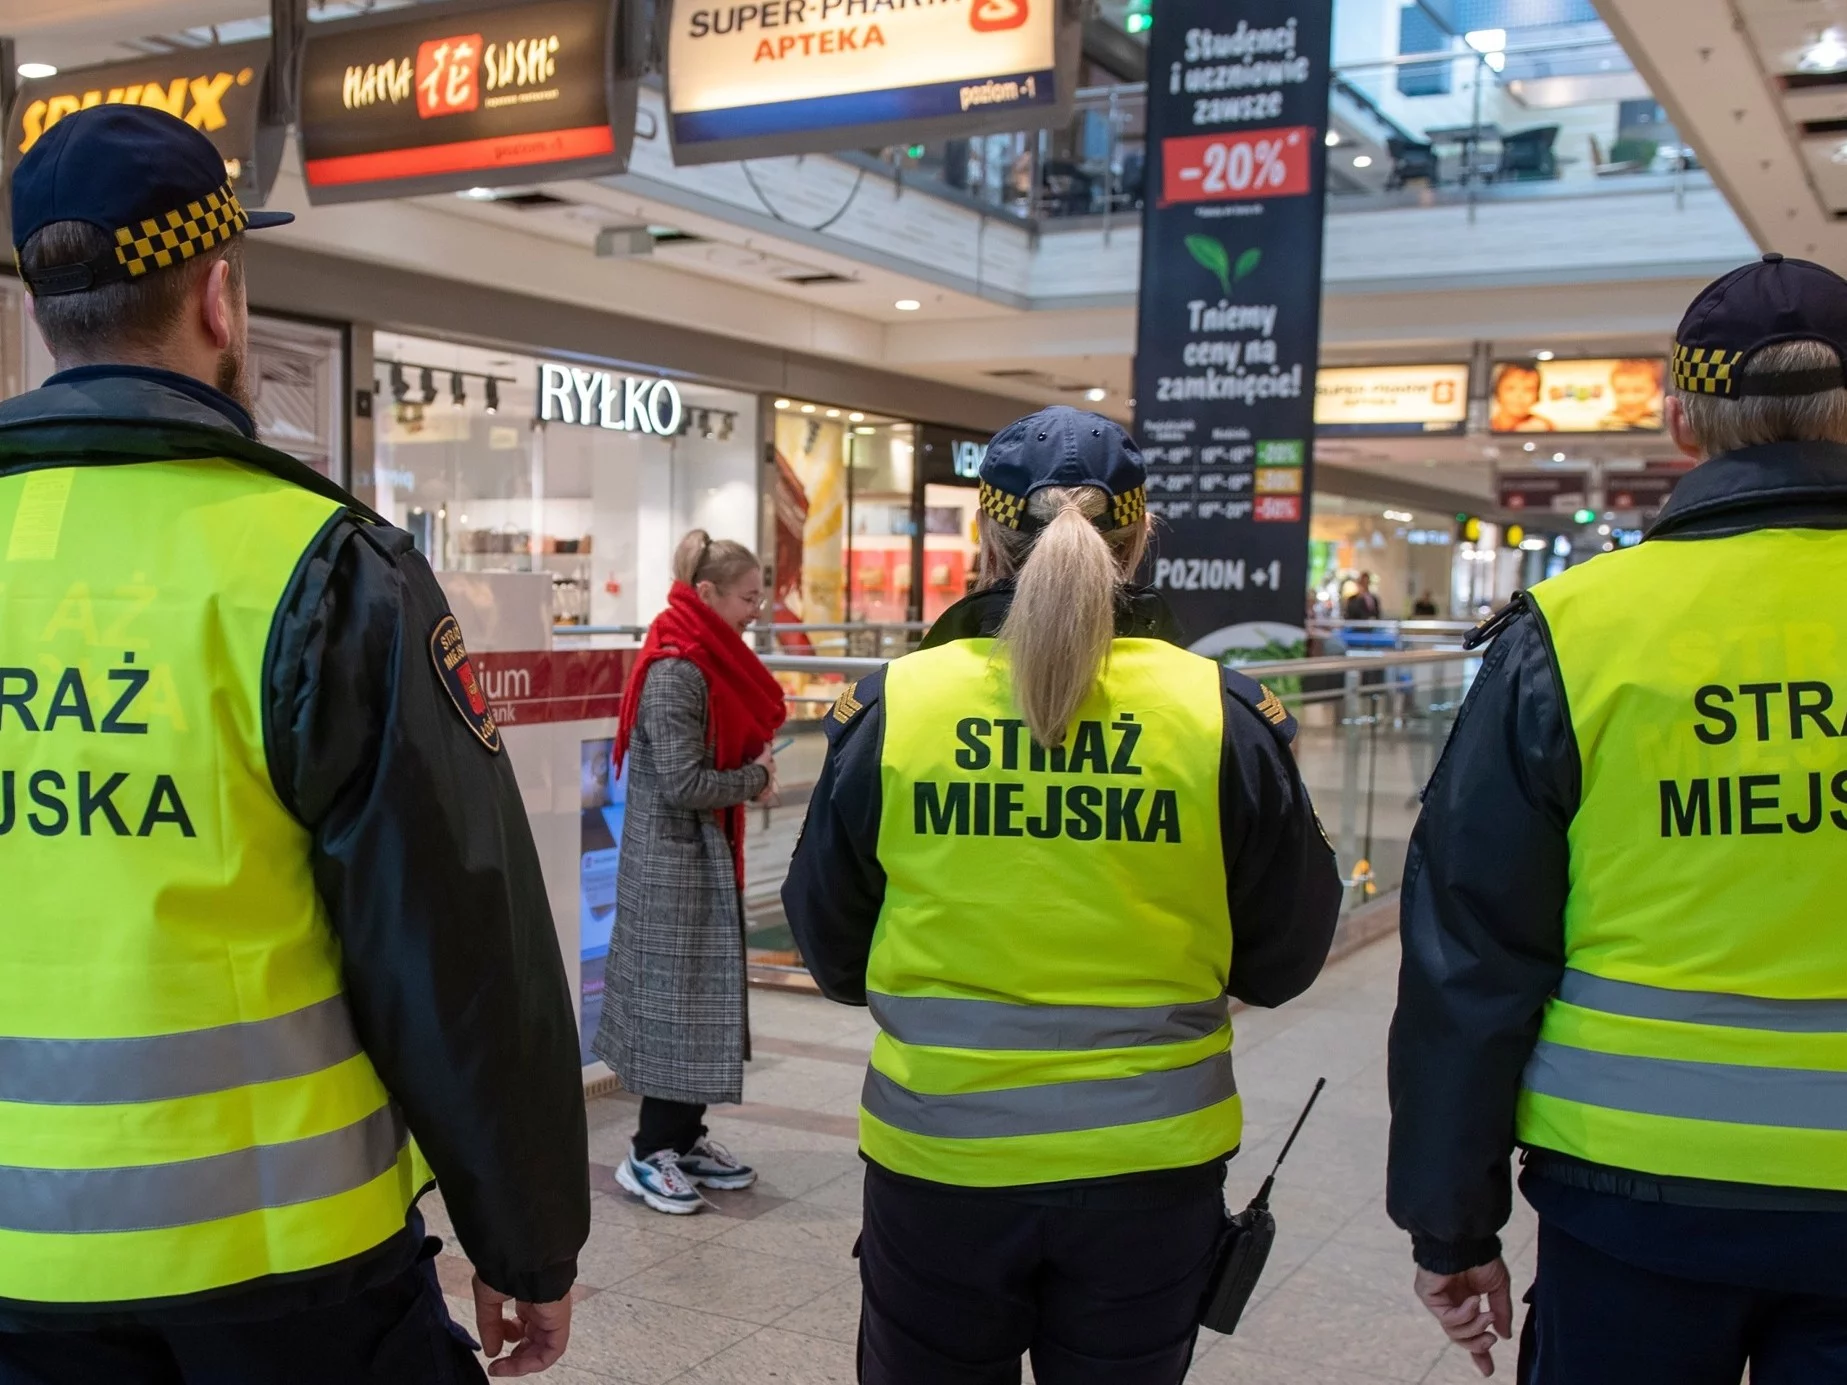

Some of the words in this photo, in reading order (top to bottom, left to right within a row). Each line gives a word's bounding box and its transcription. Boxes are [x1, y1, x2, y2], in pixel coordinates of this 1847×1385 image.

[753, 24, 885, 62] APTEKA
[1184, 17, 1298, 62] Studenci
[343, 57, 414, 110] HANA
[1169, 61, 1183, 95] i
[1184, 48, 1310, 93] uczniowie
[960, 80, 1019, 112] poziom
[1020, 76, 1036, 99] -1
[1192, 90, 1284, 125] zawsze
[1187, 299, 1278, 337] Tniemy
[1183, 341, 1241, 372] ceny
[1244, 339, 1278, 365] na
[539, 362, 683, 437] RYŁKO
[1156, 363, 1303, 406] zamknięcie!
[1154, 558, 1246, 592] POZIOM
[1250, 559, 1281, 591] +1
[0, 651, 150, 734] RAŻ
[1693, 681, 1847, 745] STR
[913, 781, 1182, 844] MIEJSKA
